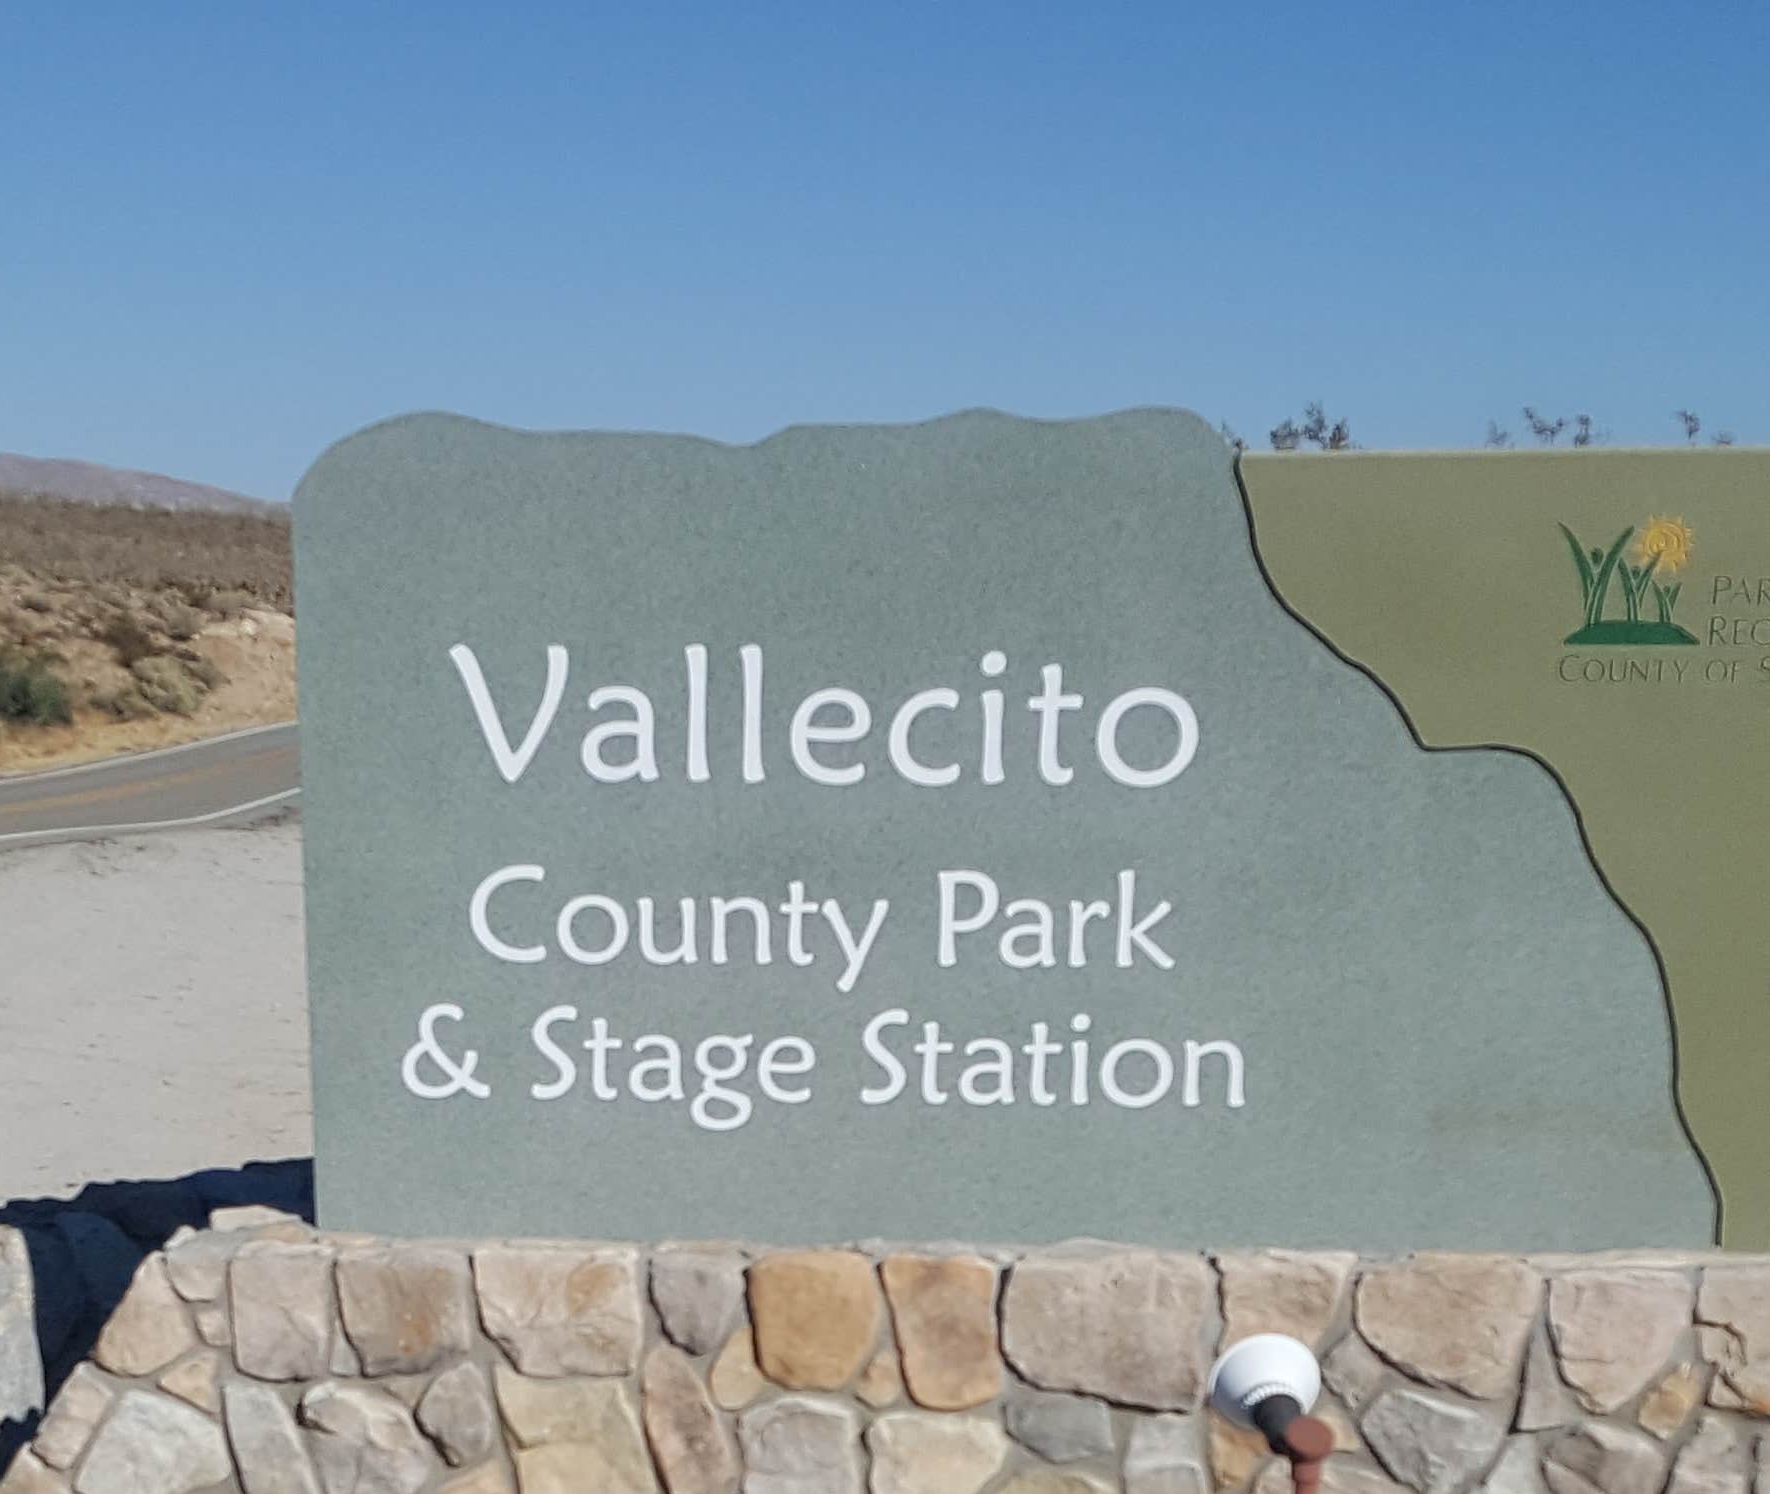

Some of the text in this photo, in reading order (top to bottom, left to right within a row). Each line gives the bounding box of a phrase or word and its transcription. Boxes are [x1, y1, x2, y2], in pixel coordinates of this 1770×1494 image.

[448, 643, 1199, 787] Vallecito
[1557, 654, 1689, 684] COUNTY
[1704, 660, 1740, 684] OF
[469, 863, 1175, 993] County Park
[401, 1002, 1246, 1130] & Stage Station
